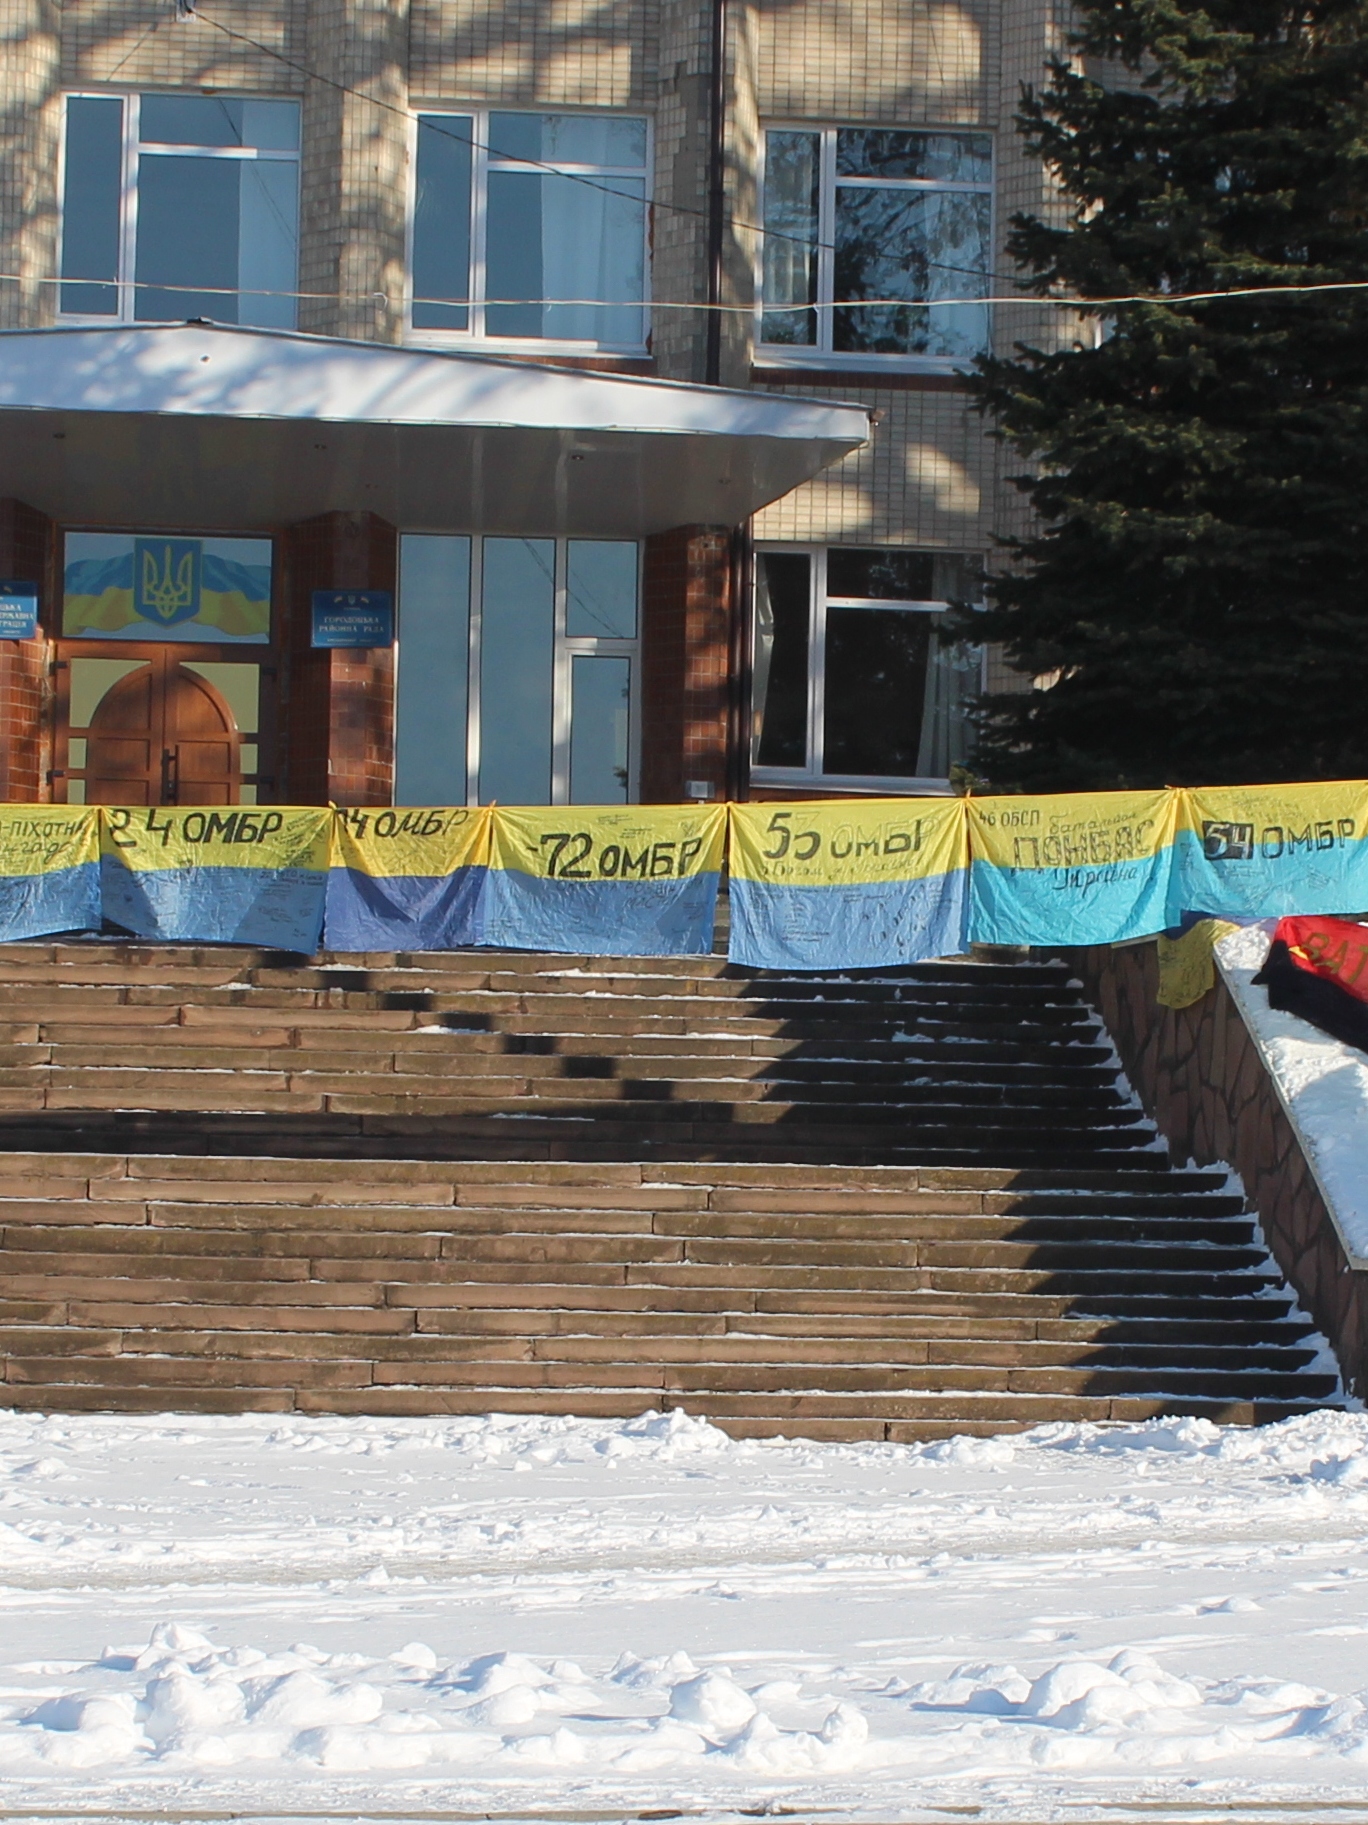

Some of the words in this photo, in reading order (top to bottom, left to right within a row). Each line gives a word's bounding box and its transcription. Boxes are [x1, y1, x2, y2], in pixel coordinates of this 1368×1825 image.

[109, 812, 174, 847] 24
[183, 812, 283, 844] ОМБР
[374, 809, 468, 839] ОМБР
[763, 811, 821, 861] 53
[978, 810, 997, 827] 46
[1000, 809, 1040, 827] ОБСП
[599, 837, 703, 878] ОМБР
[1010, 819, 1154, 877] ДОНБАС
[1203, 821, 1253, 860] 54
[1261, 818, 1355, 859] ОМБР
